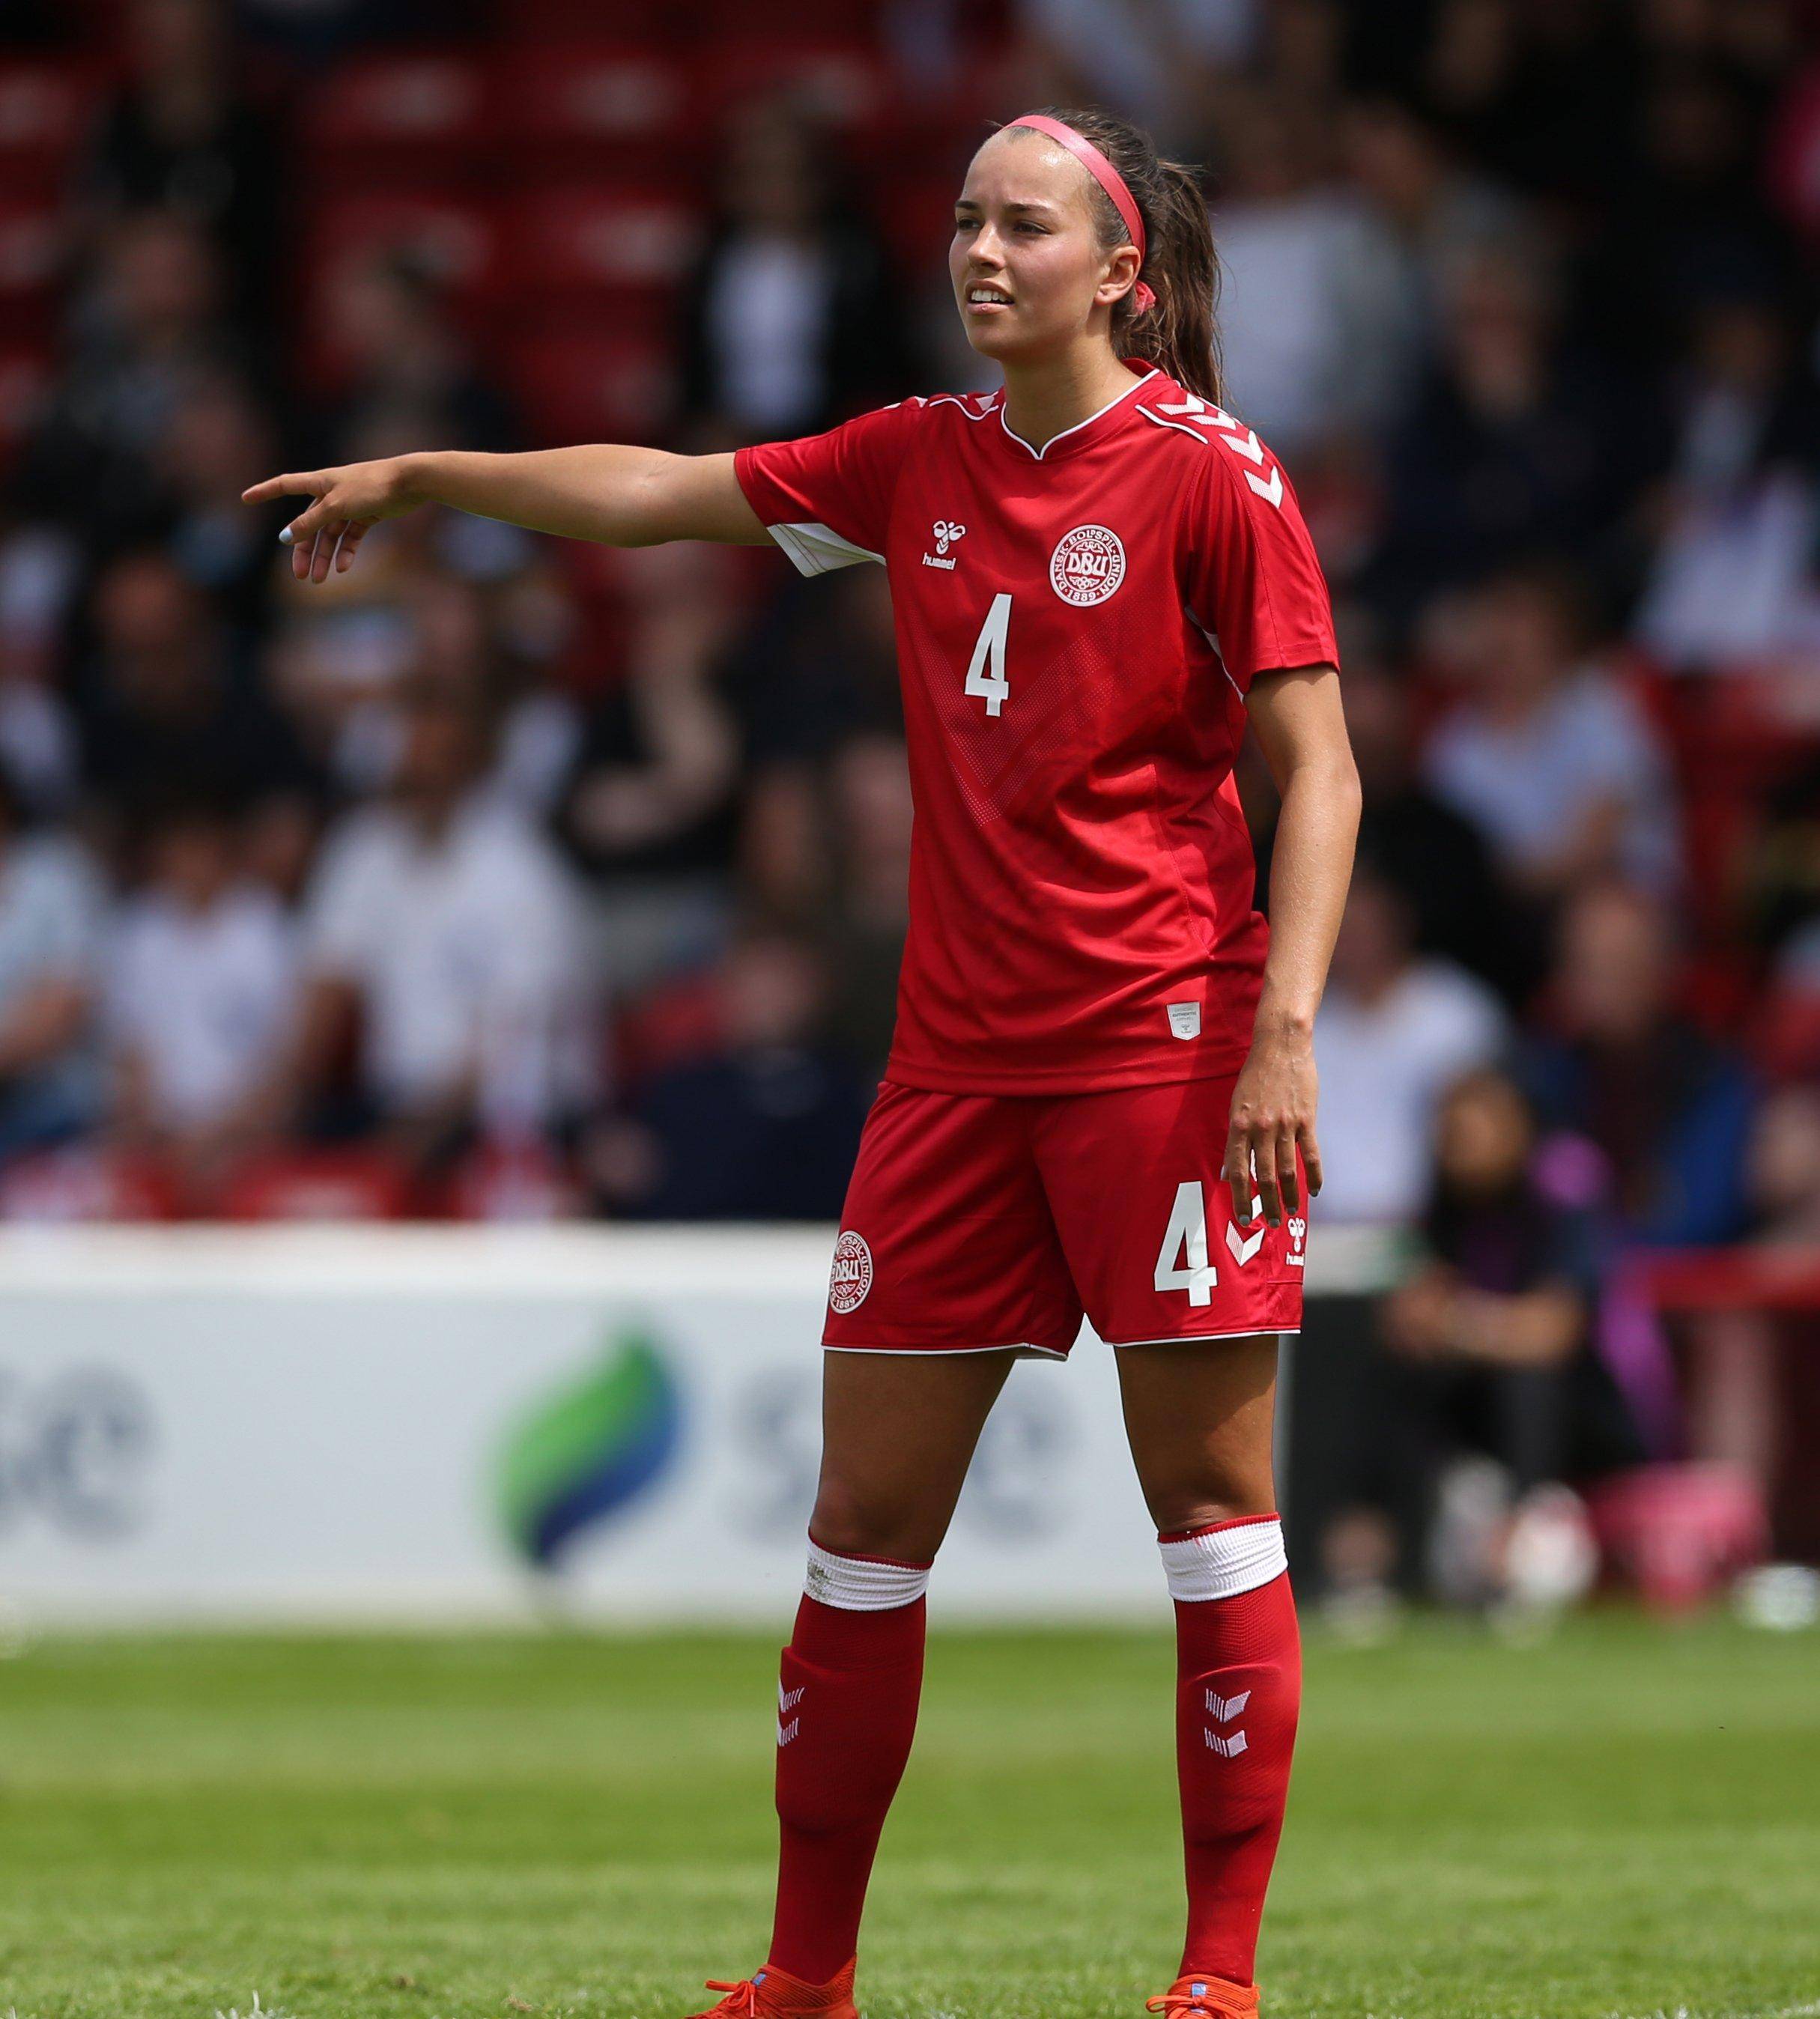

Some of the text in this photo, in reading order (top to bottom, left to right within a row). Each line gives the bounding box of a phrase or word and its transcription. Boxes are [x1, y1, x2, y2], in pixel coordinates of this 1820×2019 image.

[921, 551, 957, 571] hummel
[1055, 545, 1069, 591] DANSK
[1099, 556, 1121, 595] UNION
[1065, 552, 1109, 577] DBU
[1067, 589, 1096, 601] 1889
[964, 592, 1013, 717] 4
[1153, 1180, 1218, 1307] 4
